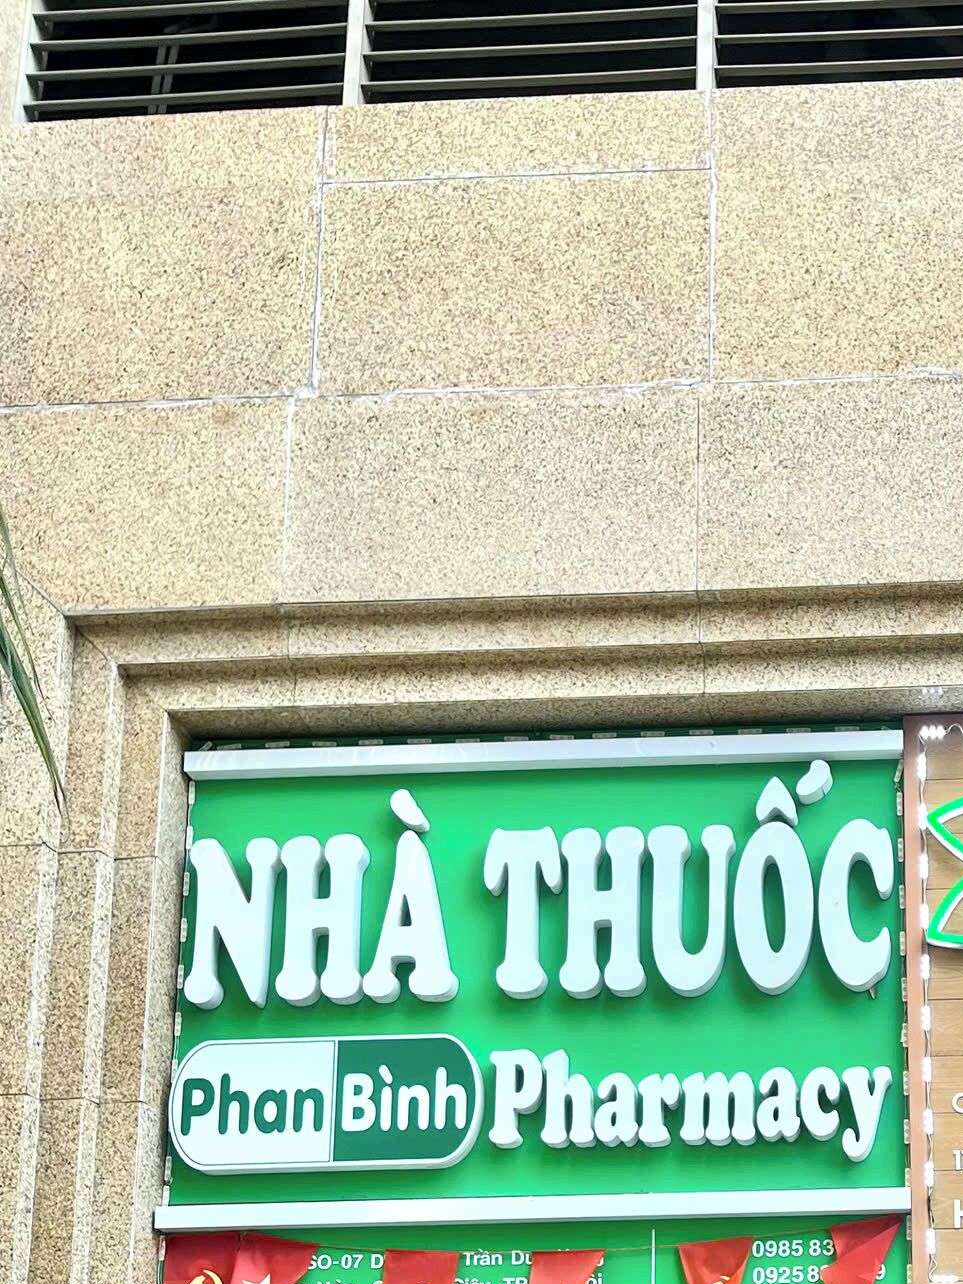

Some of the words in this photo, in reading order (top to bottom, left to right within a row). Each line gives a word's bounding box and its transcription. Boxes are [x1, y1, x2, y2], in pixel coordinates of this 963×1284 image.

[184, 789, 460, 1009] NHÀ
[483, 760, 895, 998] THUỐC
[179, 1074, 324, 1137] Phan
[340, 1064, 467, 1134] Bình
[487, 1049, 893, 1162] Pharmacy
[753, 1266, 804, 1284] 0925
